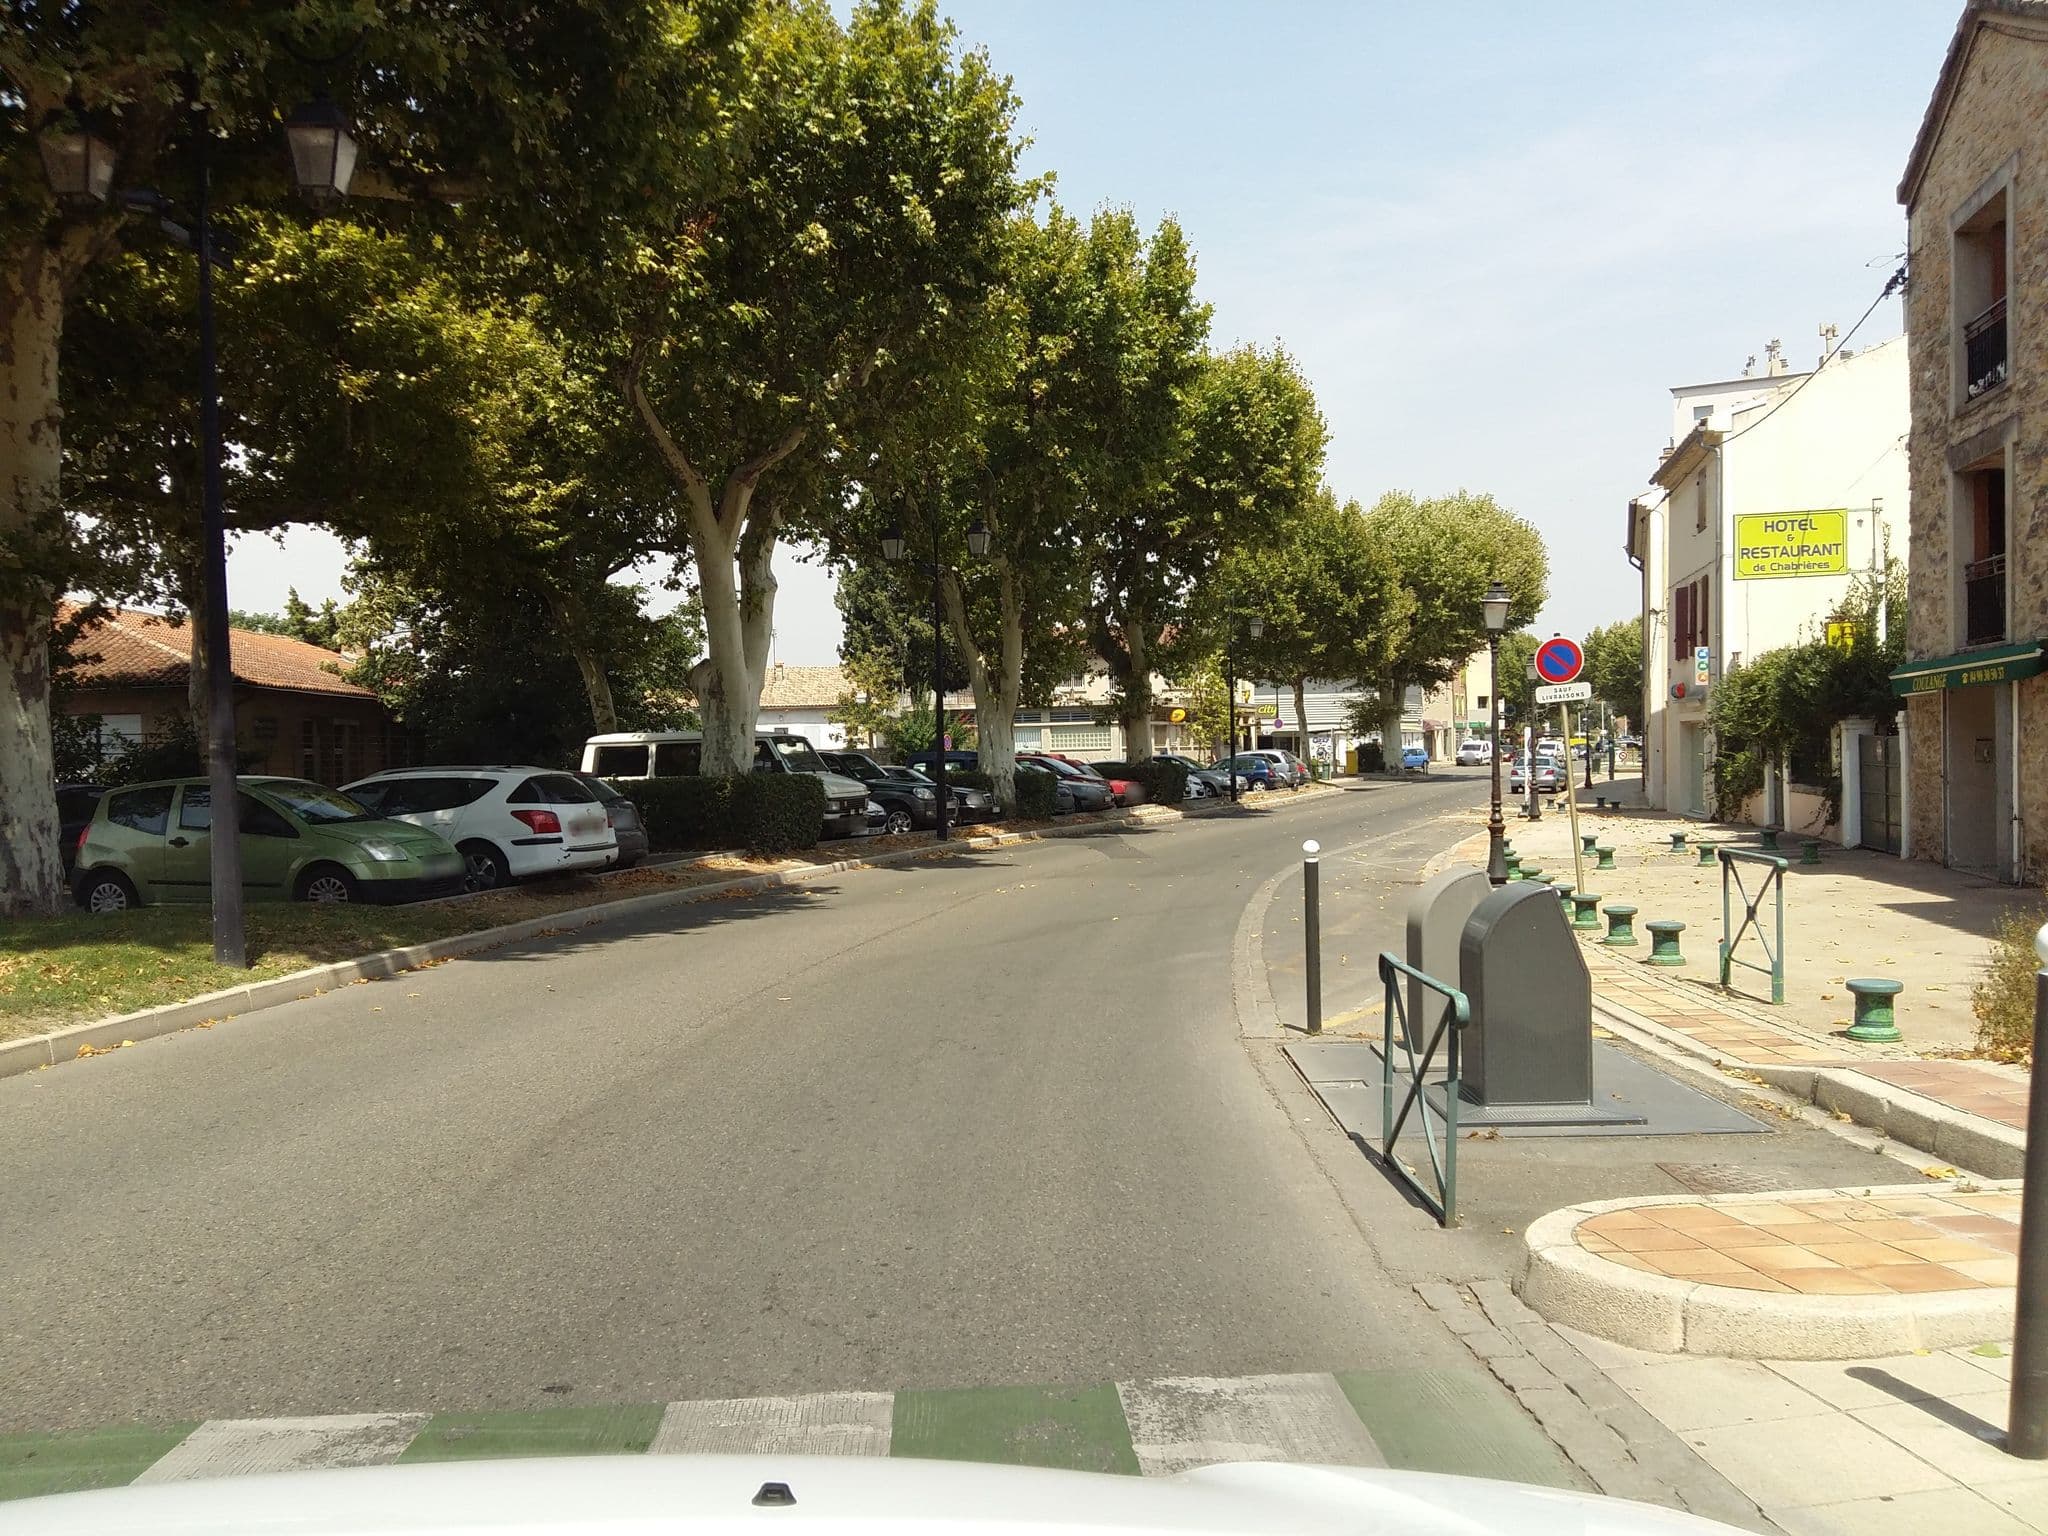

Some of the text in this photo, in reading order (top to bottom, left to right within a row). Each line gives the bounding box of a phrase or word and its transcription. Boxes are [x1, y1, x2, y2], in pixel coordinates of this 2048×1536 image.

[1764, 518, 1818, 533] HOTEL
[1786, 533, 1795, 542] &
[1740, 543, 1842, 560] RESTAURANT
[1753, 560, 1830, 572] de Chabrières
[1541, 691, 1585, 701] LIVRAISONS
[1258, 704, 1277, 717] city
